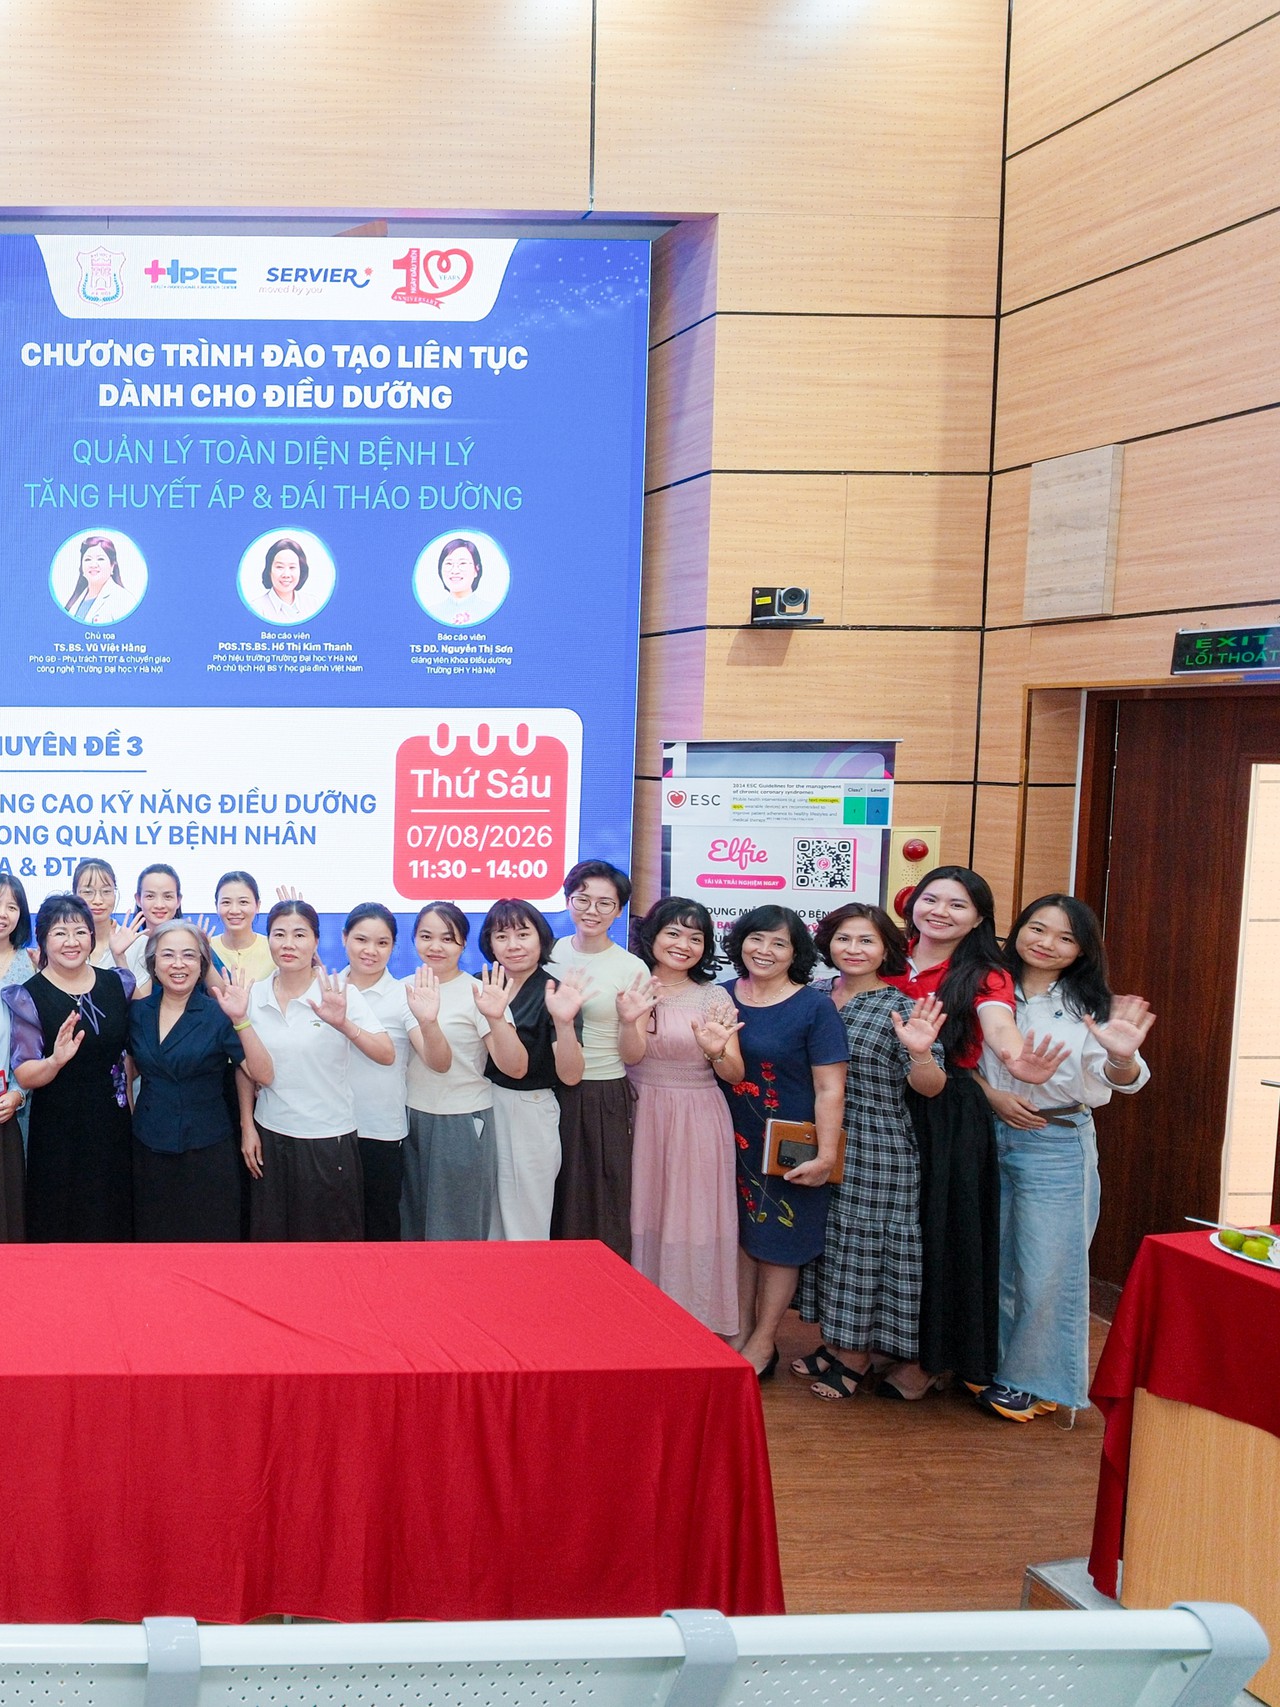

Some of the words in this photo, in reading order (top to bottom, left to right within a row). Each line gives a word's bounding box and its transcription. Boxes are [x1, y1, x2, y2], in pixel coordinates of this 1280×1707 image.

[266, 267, 370, 288] SERVIER
[258, 285, 290, 294] moved
[292, 285, 304, 296] by
[305, 287, 323, 296] you
[21, 338, 155, 367] CHƯƠNG
[161, 338, 253, 367] TRÌNH
[261, 338, 325, 369] ĐÀO
[332, 344, 391, 375] TẠO
[397, 339, 462, 369] LIÊN
[469, 346, 528, 376] TỤC
[98, 378, 184, 407] DÀNH
[190, 383, 257, 408] CHO
[262, 376, 334, 409] ĐIỀU
[342, 380, 452, 410] DƯỠNG
[73, 433, 153, 465] QUẢN
[163, 434, 194, 465] LÝ
[199, 434, 275, 465] TOÀN
[284, 435, 349, 471] DIỆN
[359, 435, 436, 471] BỆNH
[445, 436, 475, 466] LÝ
[24, 477, 99, 508] TĂNG
[108, 476, 202, 509] HUYẾT
[207, 479, 245, 509] ÁP
[252, 484, 273, 509] &
[280, 480, 326, 509] ĐÁI
[333, 480, 410, 510] THÁO
[418, 480, 523, 511] ĐƯỜNG
[53, 643, 84, 652] TS.BS.
[218, 642, 270, 651] PGS.TS.BS.
[410, 644, 421, 653] TS
[423, 644, 439, 653] DD.
[1195, 634, 1273, 649] EXIT
[1185, 649, 1213, 665] LỐI
[1217, 648, 1280, 664] THOÁT
[84, 728, 121, 756] ĐỀ
[126, 736, 143, 756] 3
[410, 767, 481, 798] Thứ
[486, 767, 551, 799] Sáu
[41, 793, 94, 814] CAO
[101, 790, 134, 814] KỸ
[140, 788, 212, 814] NĂNG
[218, 786, 278, 814] ĐIỀU
[285, 789, 376, 814] DƯỠNG
[690, 794, 721, 806] ESC
[56, 820, 128, 847] QUẢN
[135, 821, 162, 845] LÝ
[169, 820, 237, 850] BỆNH
[245, 820, 316, 845] NHÂN
[406, 824, 553, 852] 07/08/2026
[708, 837, 768, 870] Elfie
[19, 856, 37, 877] &
[43, 856, 95, 877] ĐT
[408, 859, 467, 879] 11:30
[486, 859, 548, 879] 14:00
